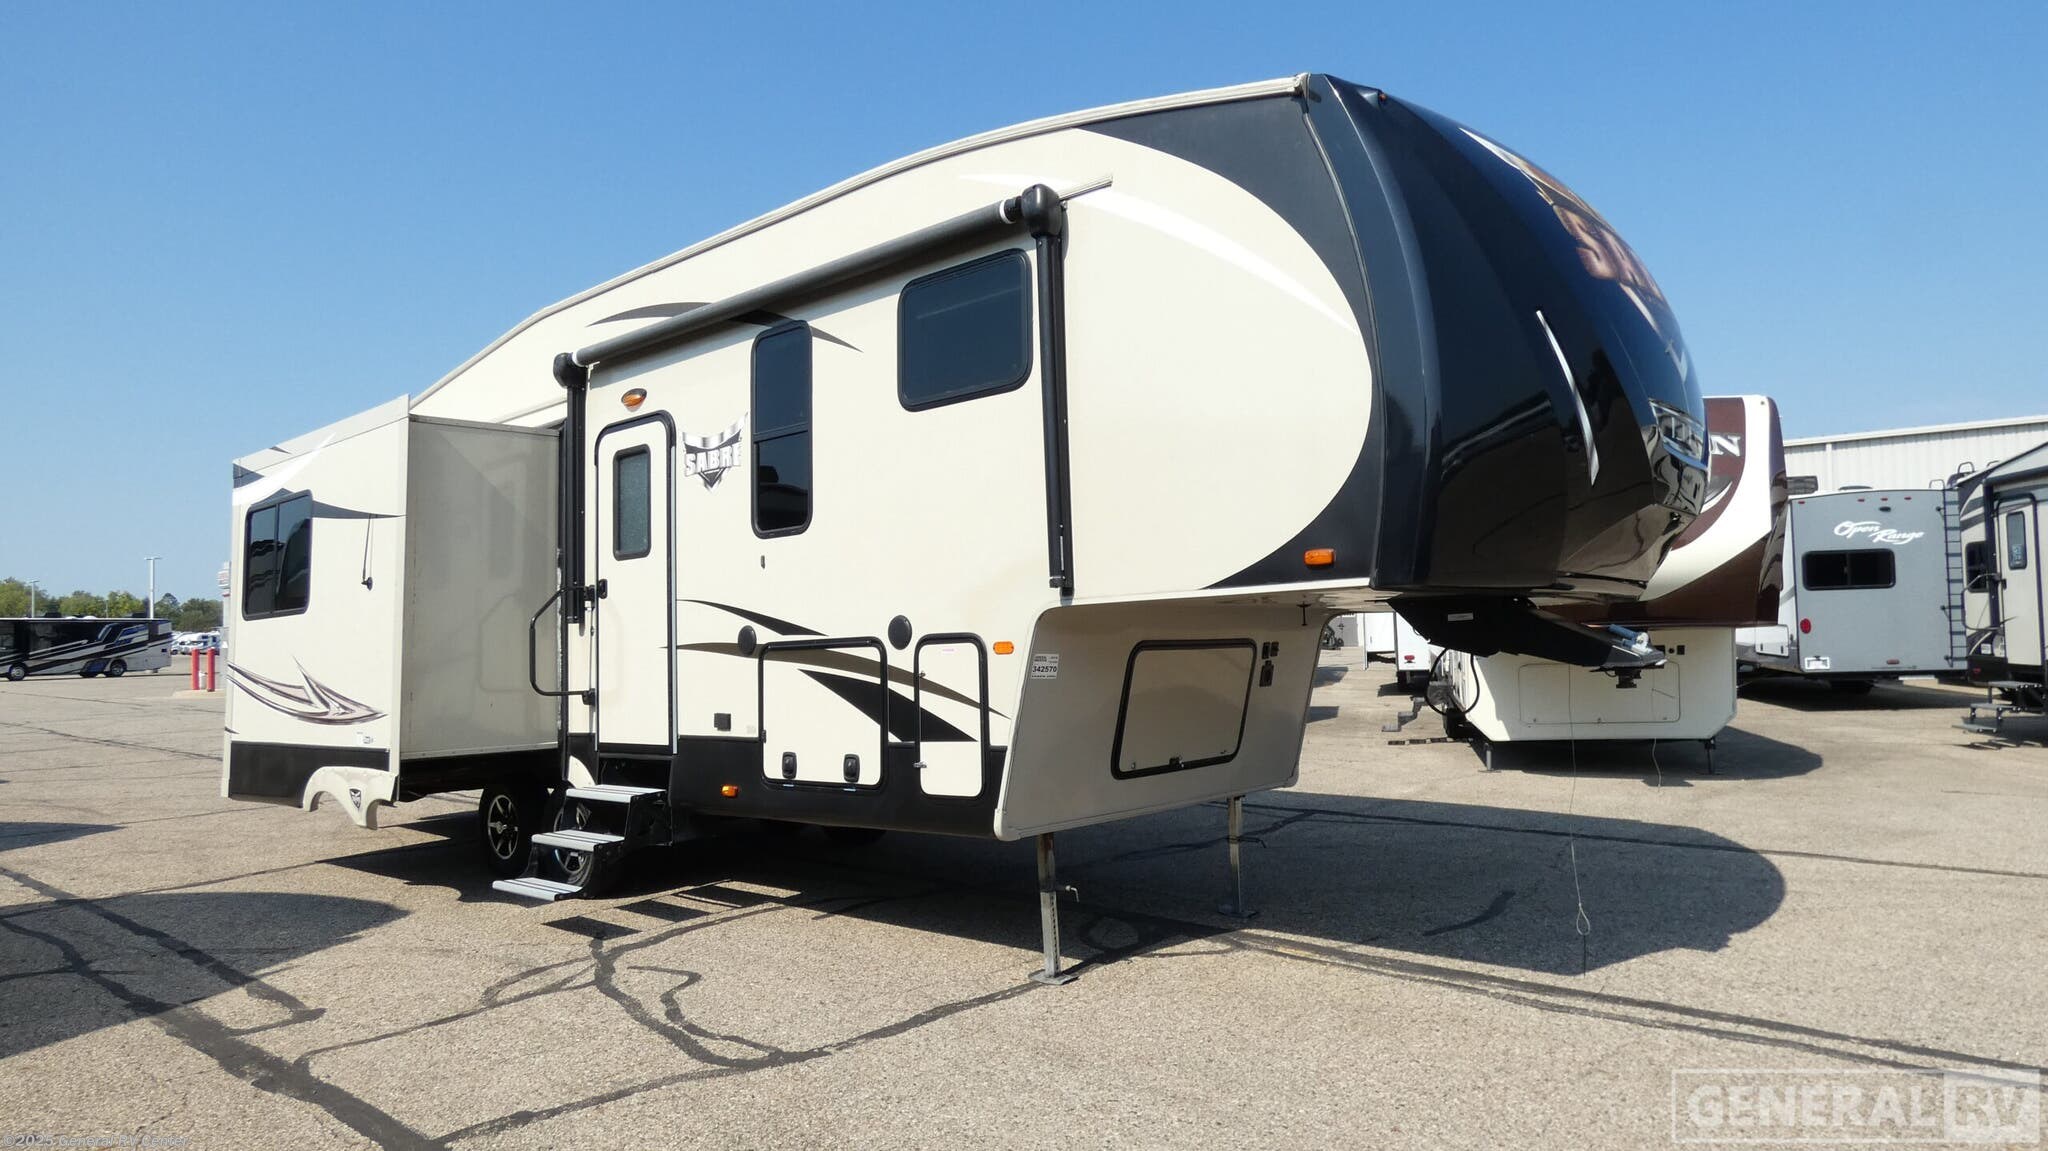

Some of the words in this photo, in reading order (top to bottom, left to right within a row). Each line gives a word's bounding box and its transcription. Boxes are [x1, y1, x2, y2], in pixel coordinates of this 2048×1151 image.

[684, 444, 742, 477] SABRE
[1834, 520, 1882, 539] Open
[1868, 528, 1925, 545] Range
[1032, 665, 1058, 673] 342570
